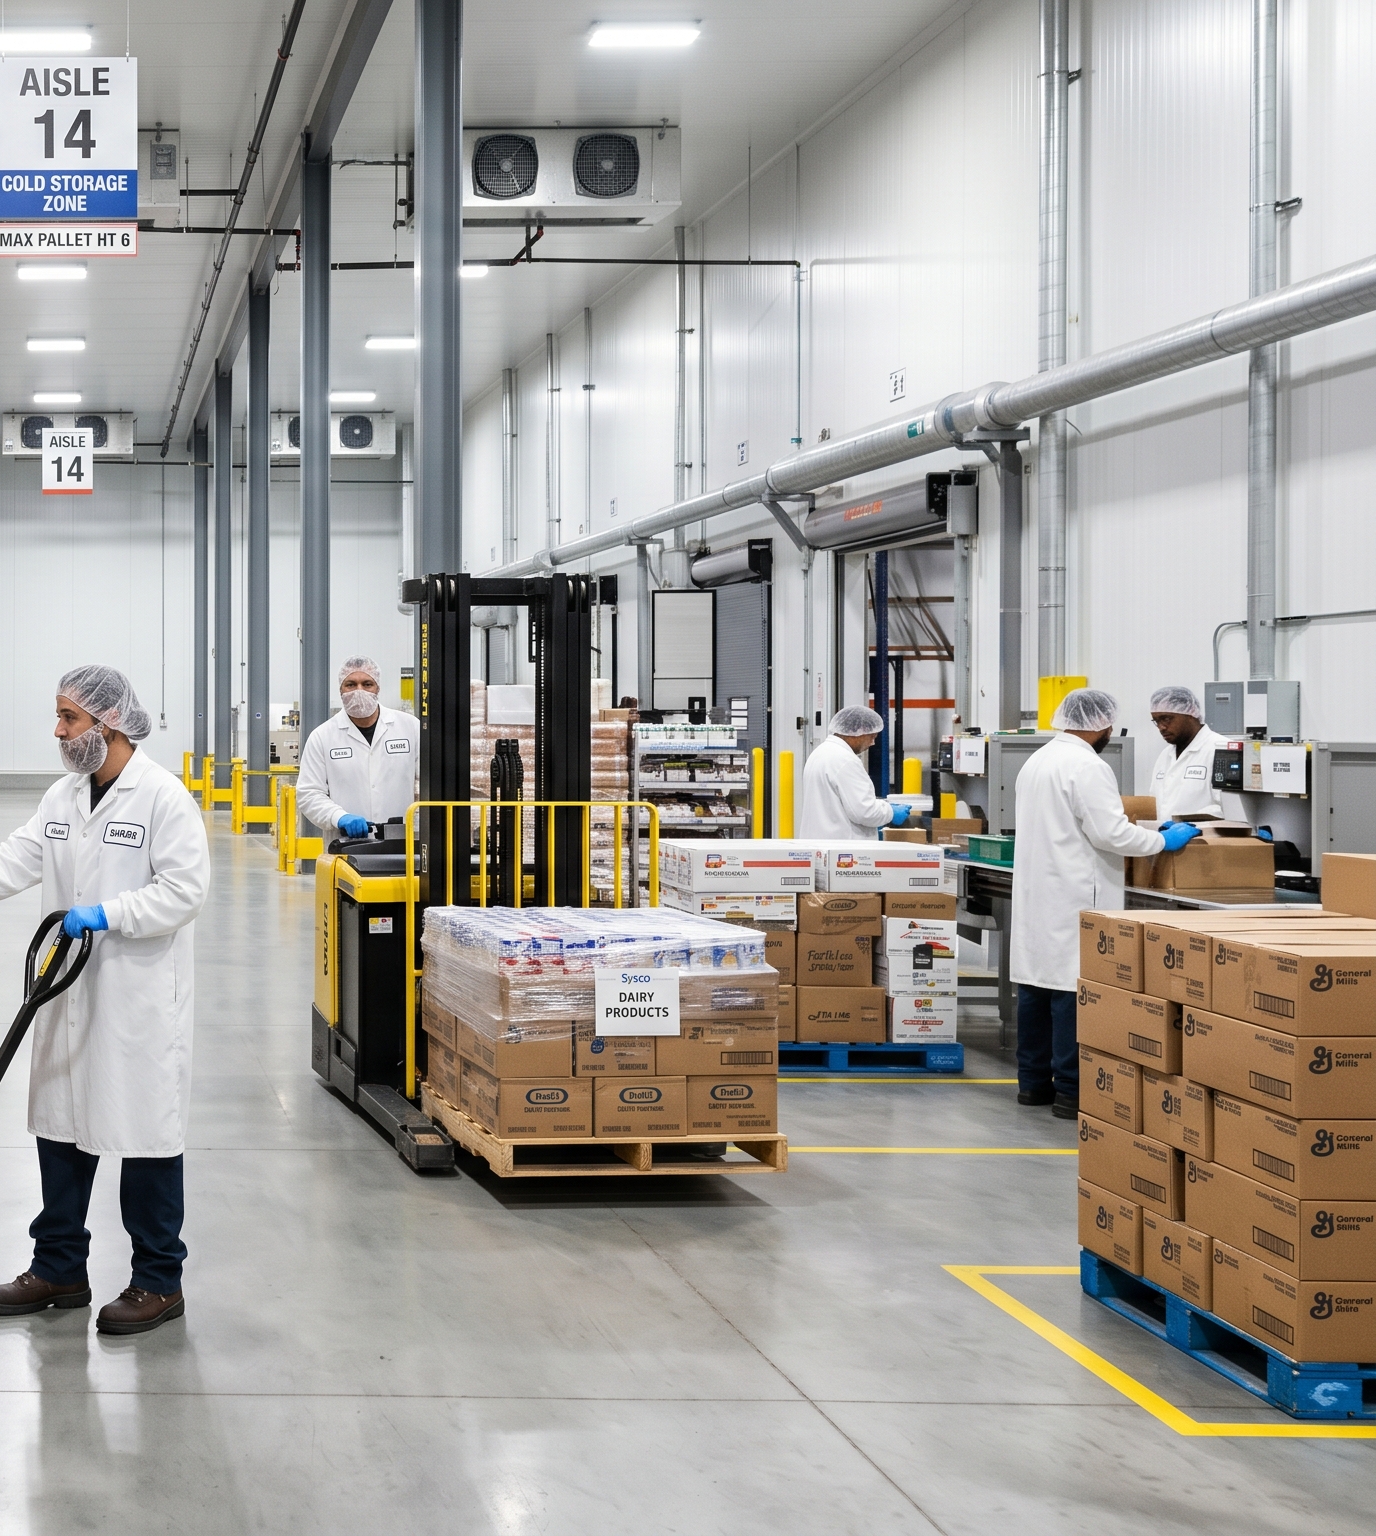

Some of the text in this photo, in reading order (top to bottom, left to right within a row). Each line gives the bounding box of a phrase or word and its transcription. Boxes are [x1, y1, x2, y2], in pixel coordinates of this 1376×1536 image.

[19, 67, 110, 96] AISLE
[34, 109, 96, 159] 14
[1, 175, 128, 192] COLD STORAGE
[42, 195, 87, 212] ZONE
[0, 232, 131, 247] MAX PALLET HT 6
[49, 435, 86, 448] AISLE
[51, 456, 84, 482] 14
[621, 973, 651, 986] Sysco
[619, 992, 655, 1003] DAIRY
[605, 1006, 669, 1018] PRODUCTS
